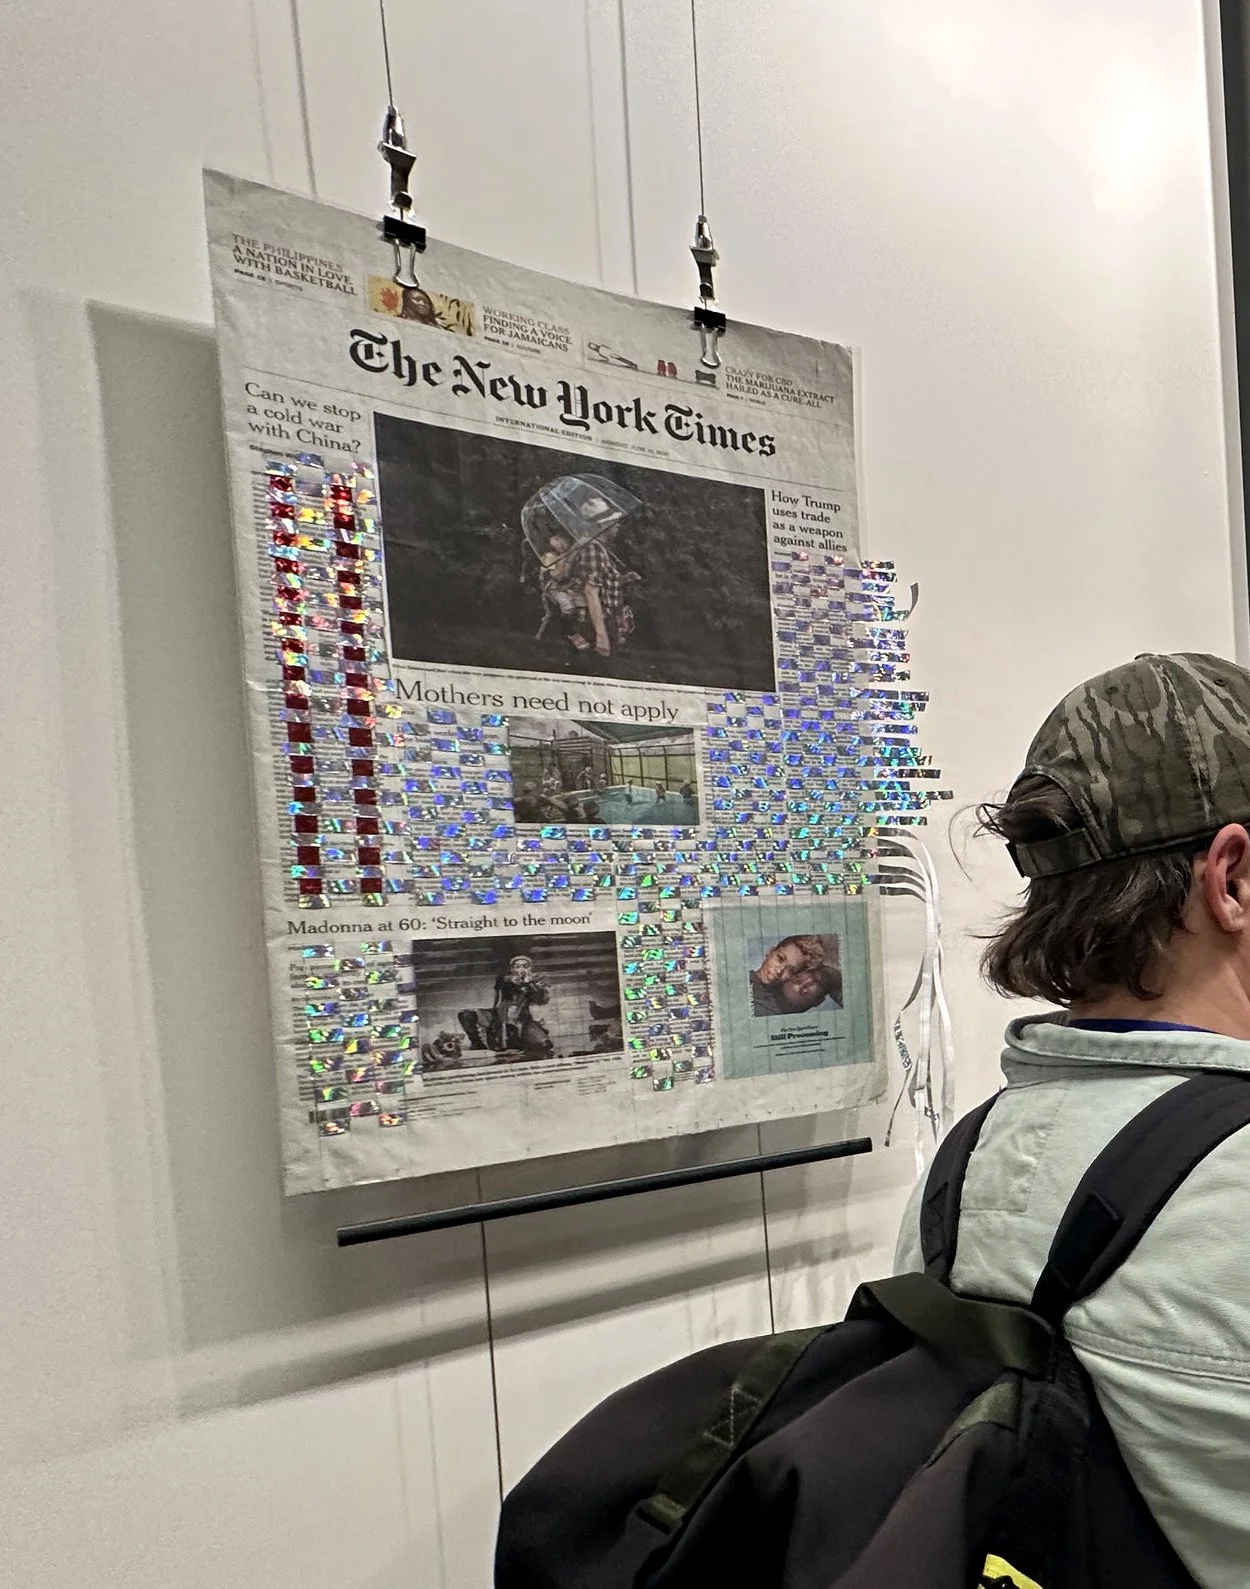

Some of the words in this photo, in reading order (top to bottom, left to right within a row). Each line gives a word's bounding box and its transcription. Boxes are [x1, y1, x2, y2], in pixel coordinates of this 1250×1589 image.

[232, 233, 260, 249] THE
[263, 243, 343, 273] PHILIPPINES
[232, 245, 242, 255] A
[246, 248, 297, 270] NATION
[300, 263, 315, 275] IN
[318, 268, 353, 285] LOVE
[233, 254, 271, 272] WITH
[275, 265, 358, 296] BASKETBALL
[483, 305, 535, 326] WORKING
[538, 321, 570, 335] CLASS
[483, 315, 528, 333] FINDING
[530, 328, 538, 336] A
[540, 330, 573, 345] VOICE
[483, 323, 505, 335] FOR
[508, 330, 569, 352] JAMAICANS
[725, 366, 755, 378] CRAZY
[756, 373, 774, 383] FOR
[775, 377, 793, 387] CBD
[726, 374, 744, 384] THE
[745, 379, 796, 395] MARIJUANA
[797, 389, 835, 404] EXTRACT
[245, 381, 285, 404] Can
[290, 396, 318, 411] we
[323, 404, 361, 422] stop
[349, 328, 442, 387] The
[452, 354, 548, 409] New
[557, 380, 659, 435] York
[664, 402, 777, 458] Times
[726, 382, 758, 395] HAILED
[760, 390, 772, 398] AS
[781, 394, 822, 408] CURE-ALL
[246, 404, 259, 415] a
[263, 408, 302, 425] cold
[308, 418, 344, 433] war
[496, 415, 560, 435] INTERNATIONAL
[561, 429, 592, 441] EDITION
[248, 422, 290, 439] with
[296, 428, 361, 454] China?
[771, 490, 799, 504] How
[802, 494, 841, 513] Trump
[772, 507, 798, 519] uses
[801, 511, 831, 523] trade
[772, 521, 786, 530] as
[789, 524, 796, 532] a
[799, 525, 844, 539] weapon
[773, 535, 815, 548] against
[818, 539, 848, 552] allies
[394, 678, 504, 707] Mothers
[512, 692, 569, 713] need
[578, 699, 614, 715] not
[621, 701, 679, 723] apply
[287, 920, 373, 935] Madonna
[378, 921, 394, 932] at
[398, 918, 427, 931] 60:
[503, 917, 518, 927] to
[523, 914, 546, 926] the
